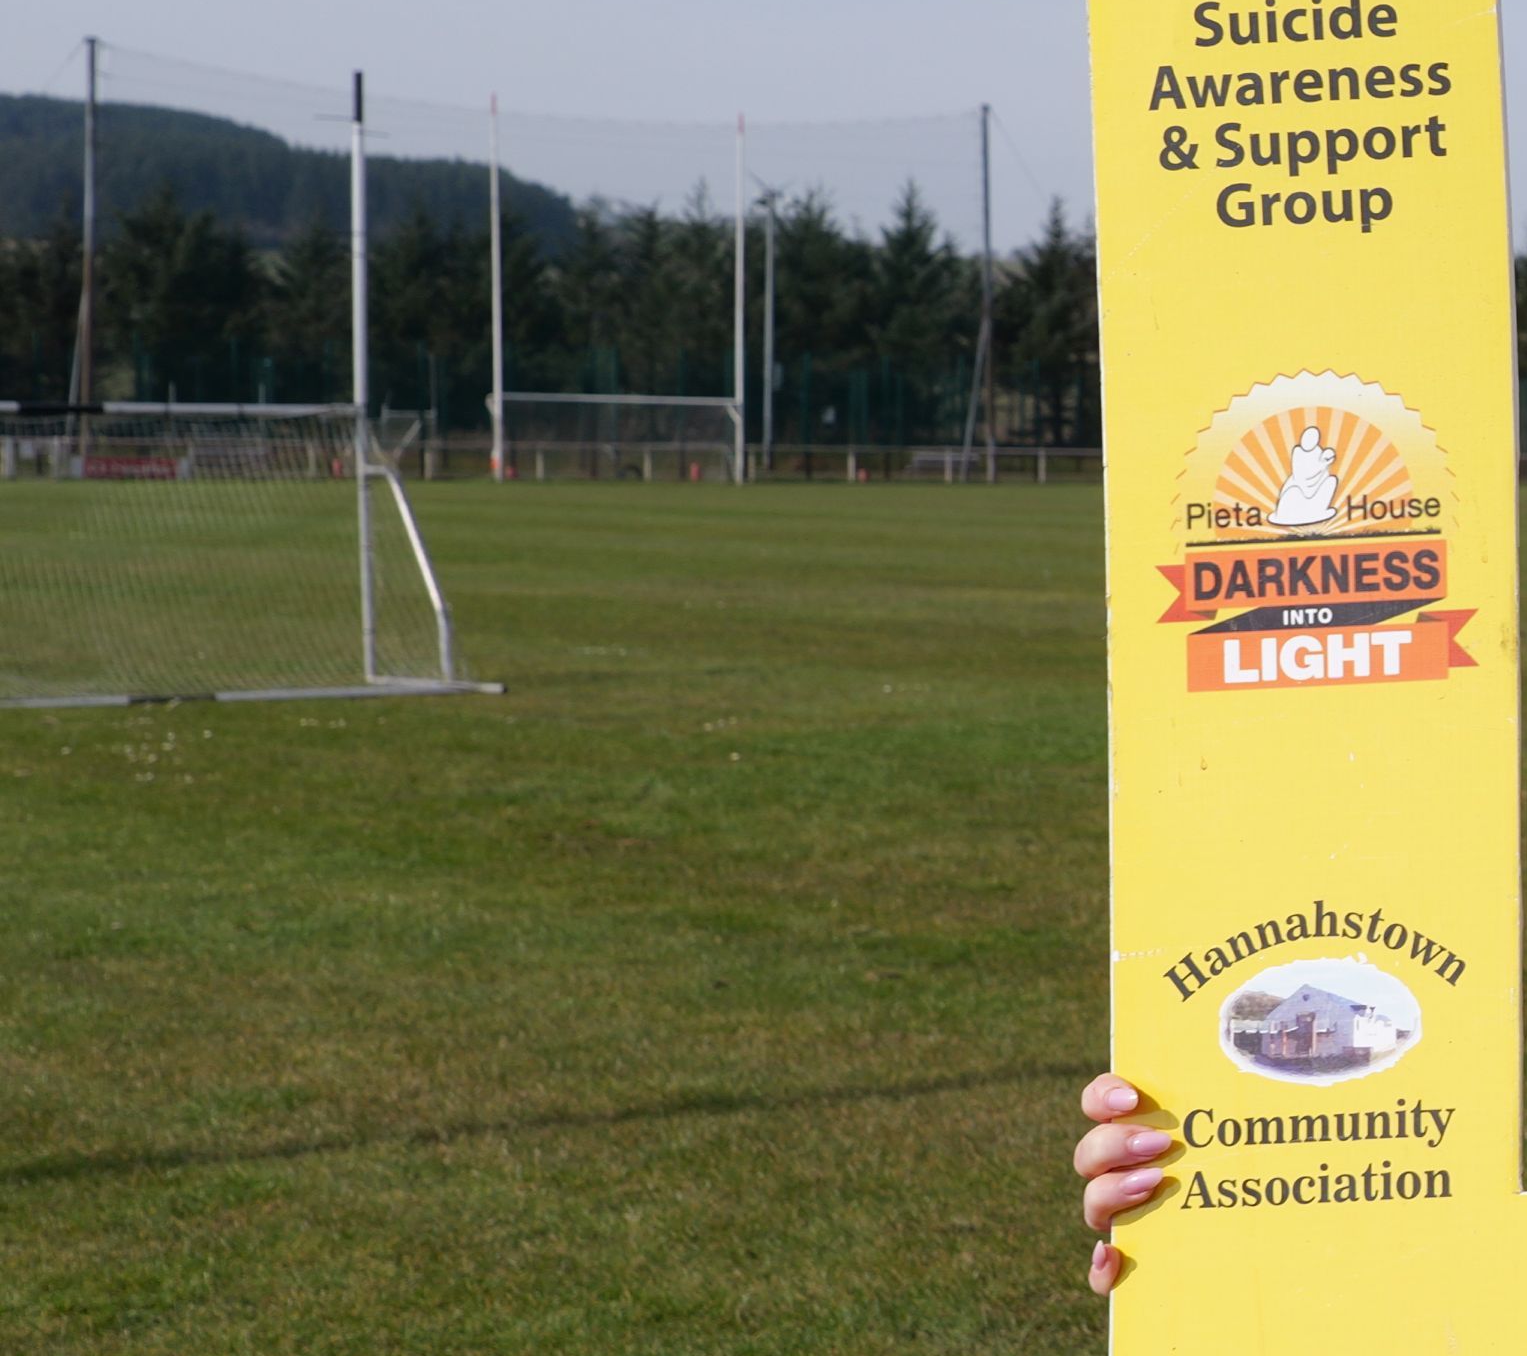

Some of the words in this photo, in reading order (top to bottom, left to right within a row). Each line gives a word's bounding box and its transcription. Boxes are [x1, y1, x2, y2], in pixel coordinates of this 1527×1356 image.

[1148, 62, 1451, 111] Awareness
[1159, 126, 1200, 171] &
[1215, 116, 1447, 176] Support
[1217, 183, 1393, 233] Group
[1186, 503, 1262, 529] Pieta
[1346, 495, 1441, 521] House
[1194, 549, 1440, 601] DARKNESS
[1283, 608, 1333, 625] INTO
[1224, 630, 1412, 684] LIGHT
[1163, 900, 1466, 1002] Hannahstown
[1183, 1099, 1456, 1148] Community
[1180, 1161, 1452, 1209] Association
